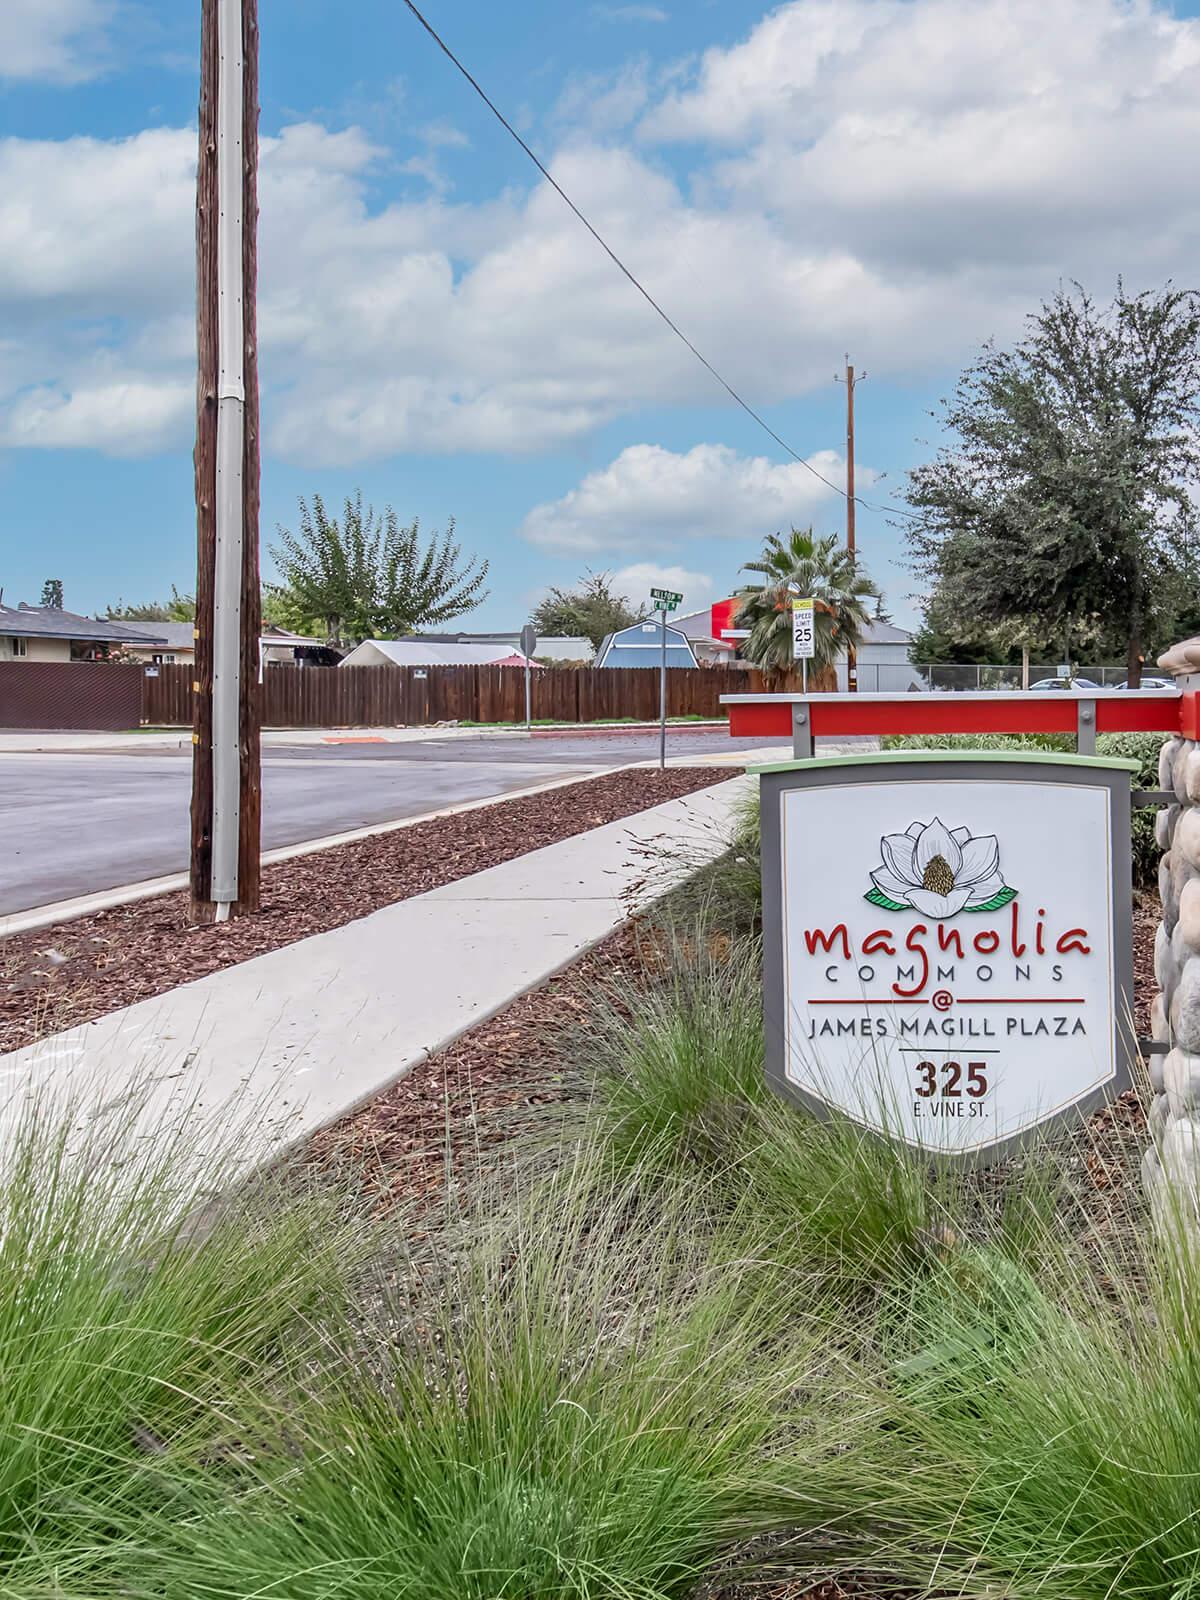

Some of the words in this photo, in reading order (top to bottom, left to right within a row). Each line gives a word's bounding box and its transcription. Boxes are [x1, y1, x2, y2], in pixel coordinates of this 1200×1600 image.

[795, 628, 812, 642] 25
[804, 902, 1091, 997] magnolia
[825, 964, 1064, 982] COMMONS
[931, 990, 954, 1012] @
[808, 1018, 888, 1040] JAMES
[900, 1018, 996, 1036] MAGILL
[1006, 1017, 1087, 1036] PLAZA
[914, 1061, 988, 1098] 325
[914, 1102, 926, 1117] E.
[930, 1102, 965, 1118] VINE
[969, 1102, 989, 1118] ST.
